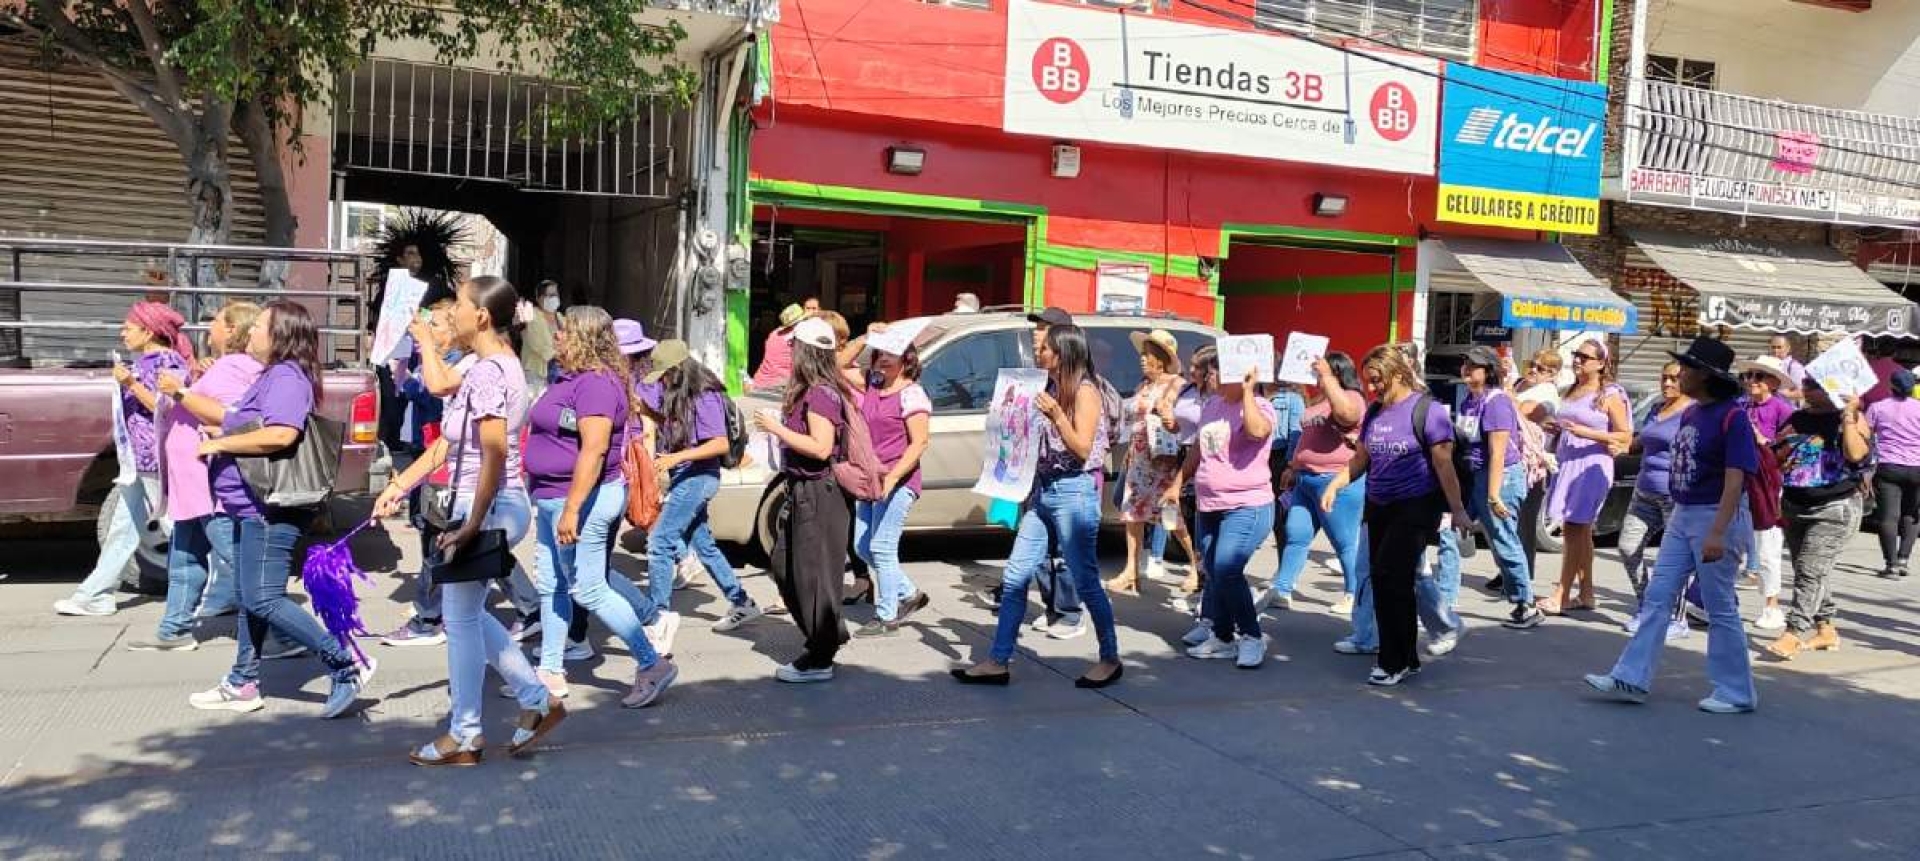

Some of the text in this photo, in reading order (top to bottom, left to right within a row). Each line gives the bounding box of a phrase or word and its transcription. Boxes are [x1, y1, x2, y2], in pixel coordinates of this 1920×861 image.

[1053, 42, 1072, 66] B
[1041, 66, 1080, 92] BB
[1142, 50, 1324, 102] Tiendas 3B
[1388, 88, 1402, 107] B
[1102, 92, 1132, 111] Los
[1138, 96, 1203, 119] Mejores
[1208, 105, 1267, 126] Precios
[1272, 112, 1317, 132] Cerca
[1322, 119, 1340, 134] de
[1378, 109, 1409, 132] BB
[1493, 113, 1597, 158] telcel
[1446, 194, 1595, 225] CELULARES A CRÉDITO
